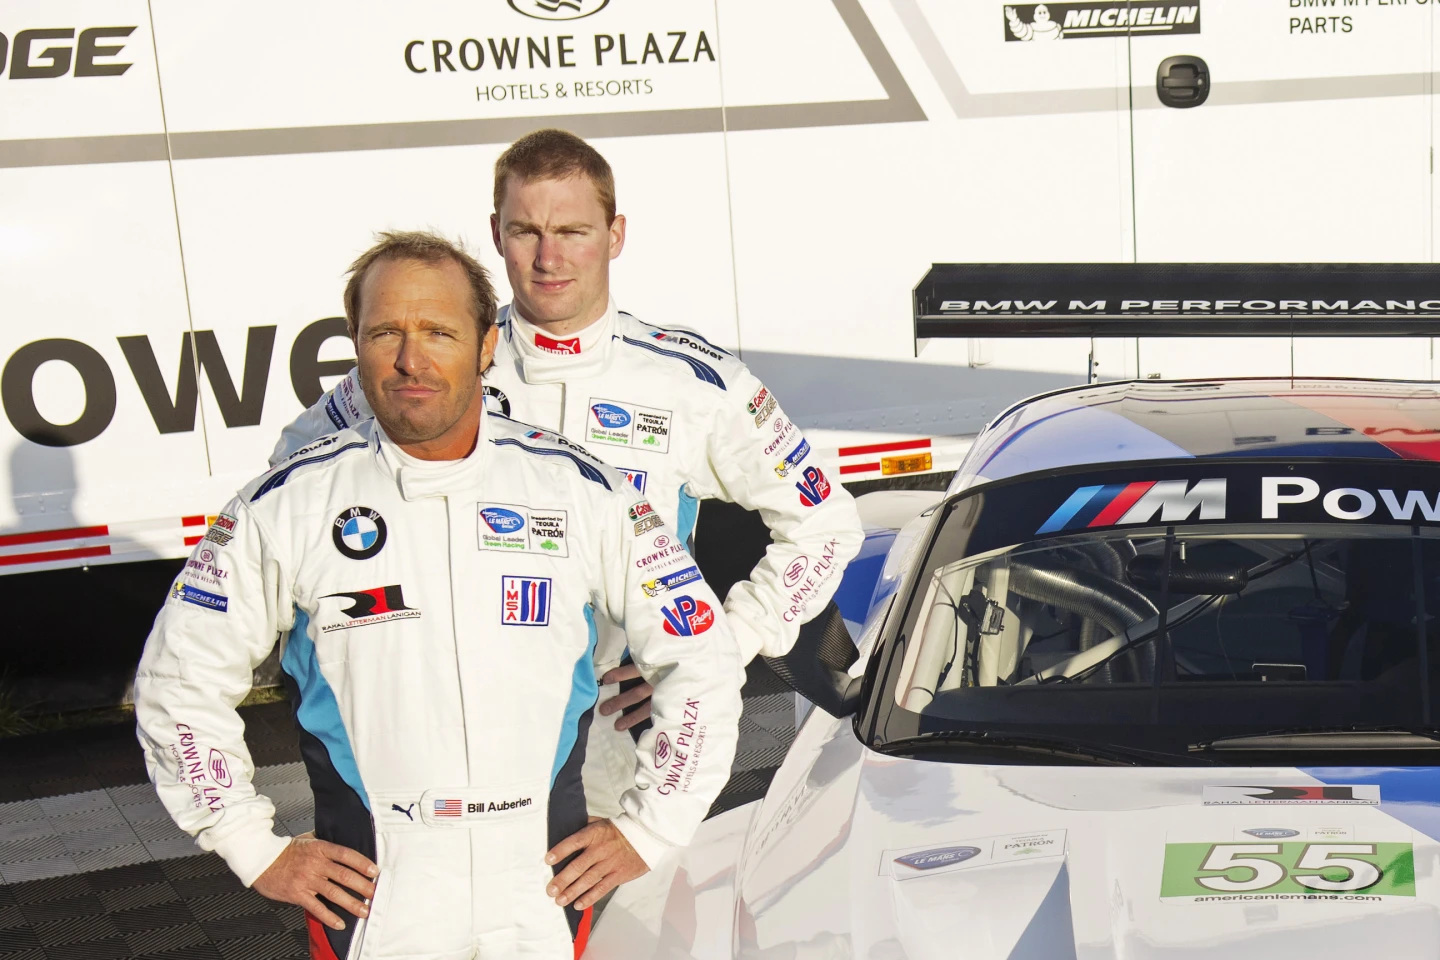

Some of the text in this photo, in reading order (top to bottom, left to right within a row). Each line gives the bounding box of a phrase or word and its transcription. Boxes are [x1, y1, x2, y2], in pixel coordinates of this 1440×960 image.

[1062, 5, 1198, 28] MICHELIN
[1289, 16, 1353, 34] PARTS
[0, 26, 138, 79] GE
[404, 31, 716, 74] CROWNE PLAZA
[476, 79, 653, 101] HOTELS & RESORTS
[939, 300, 1057, 311] BMW
[1067, 300, 1107, 311] M
[678, 337, 724, 362] Power
[764, 429, 786, 455] CROWNE
[795, 465, 820, 506] VP
[1117, 477, 1227, 523] M
[334, 507, 382, 528] BMW
[531, 527, 565, 539] PATRÓN
[502, 541, 526, 549] Racing
[635, 548, 669, 569] CROWNE
[782, 538, 841, 623] CRWNE PLAZA
[186, 589, 227, 608] MICHELIN
[505, 580, 519, 621] IMSA
[322, 611, 422, 631] RAHAL LETTERMAN LANIGAN
[660, 594, 697, 637] VP
[677, 697, 700, 747] PLAZA
[682, 765, 697, 793] HOTELS
[694, 725, 708, 760] RESORTS
[467, 797, 532, 813] Bill Auberlen
[914, 853, 955, 866] LE MANS
[1193, 843, 1384, 892] 55
[1194, 893, 1383, 903] americanlemans.com
